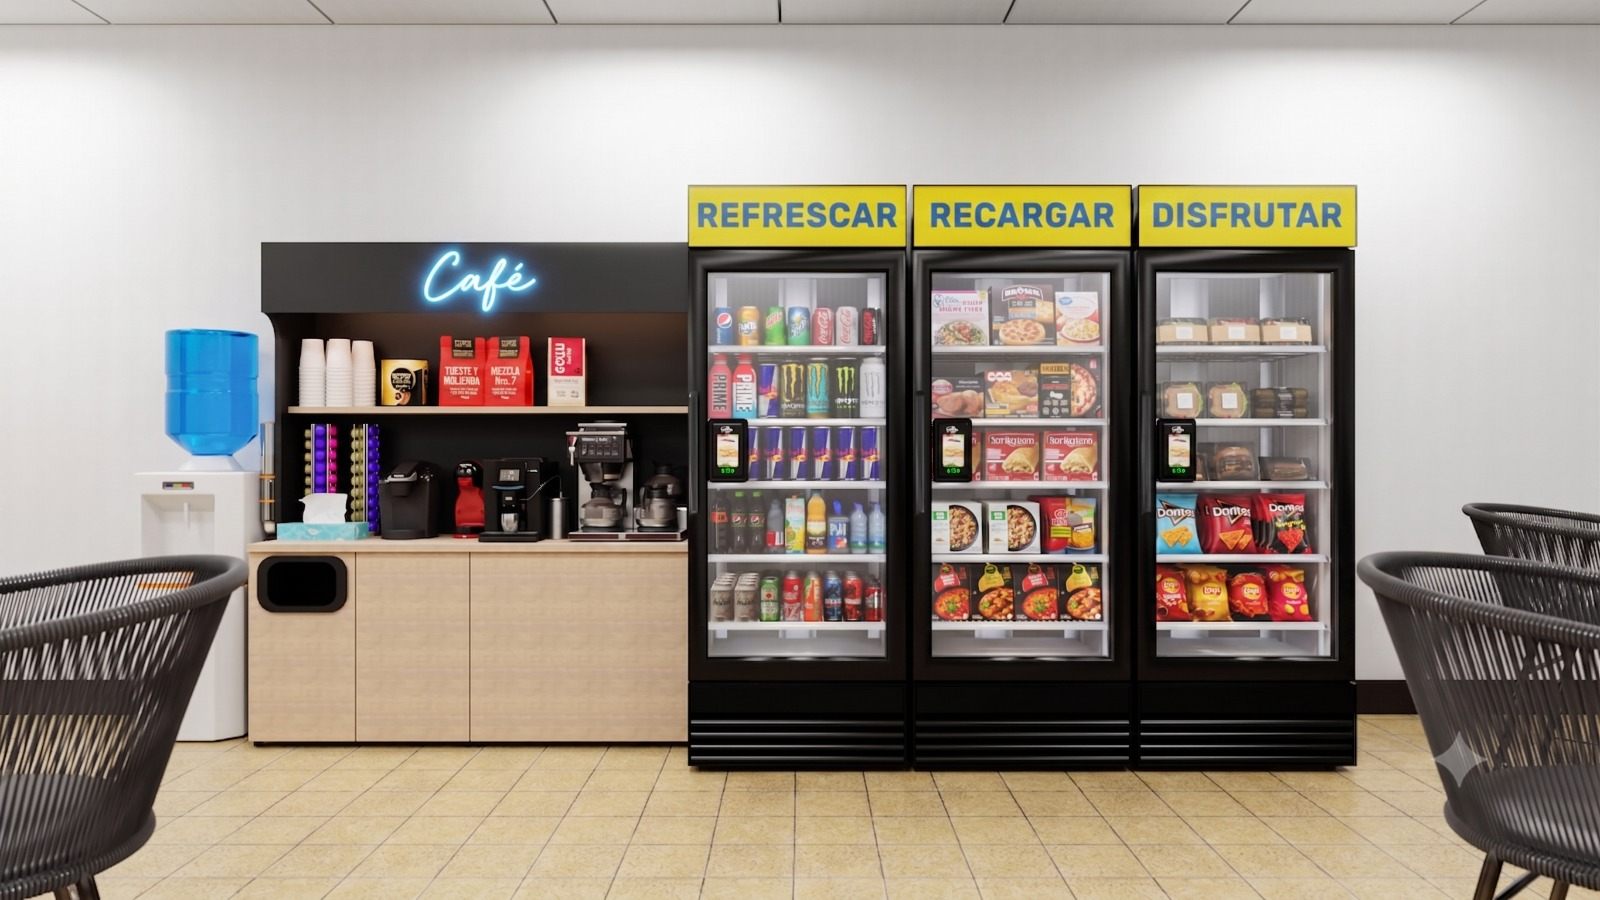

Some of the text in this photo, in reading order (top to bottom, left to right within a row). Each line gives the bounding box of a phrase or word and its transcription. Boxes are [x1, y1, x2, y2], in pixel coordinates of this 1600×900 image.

[698, 203, 896, 227] REFRESCAR
[930, 203, 1114, 227] RECARGAR
[1152, 203, 1341, 227] DISFRUTAR
[423, 250, 537, 312] Café
[473, 366, 479, 376] Y
[511, 376, 517, 386] 7
[712, 373, 728, 411] PRIME
[736, 374, 753, 411] PRIME
